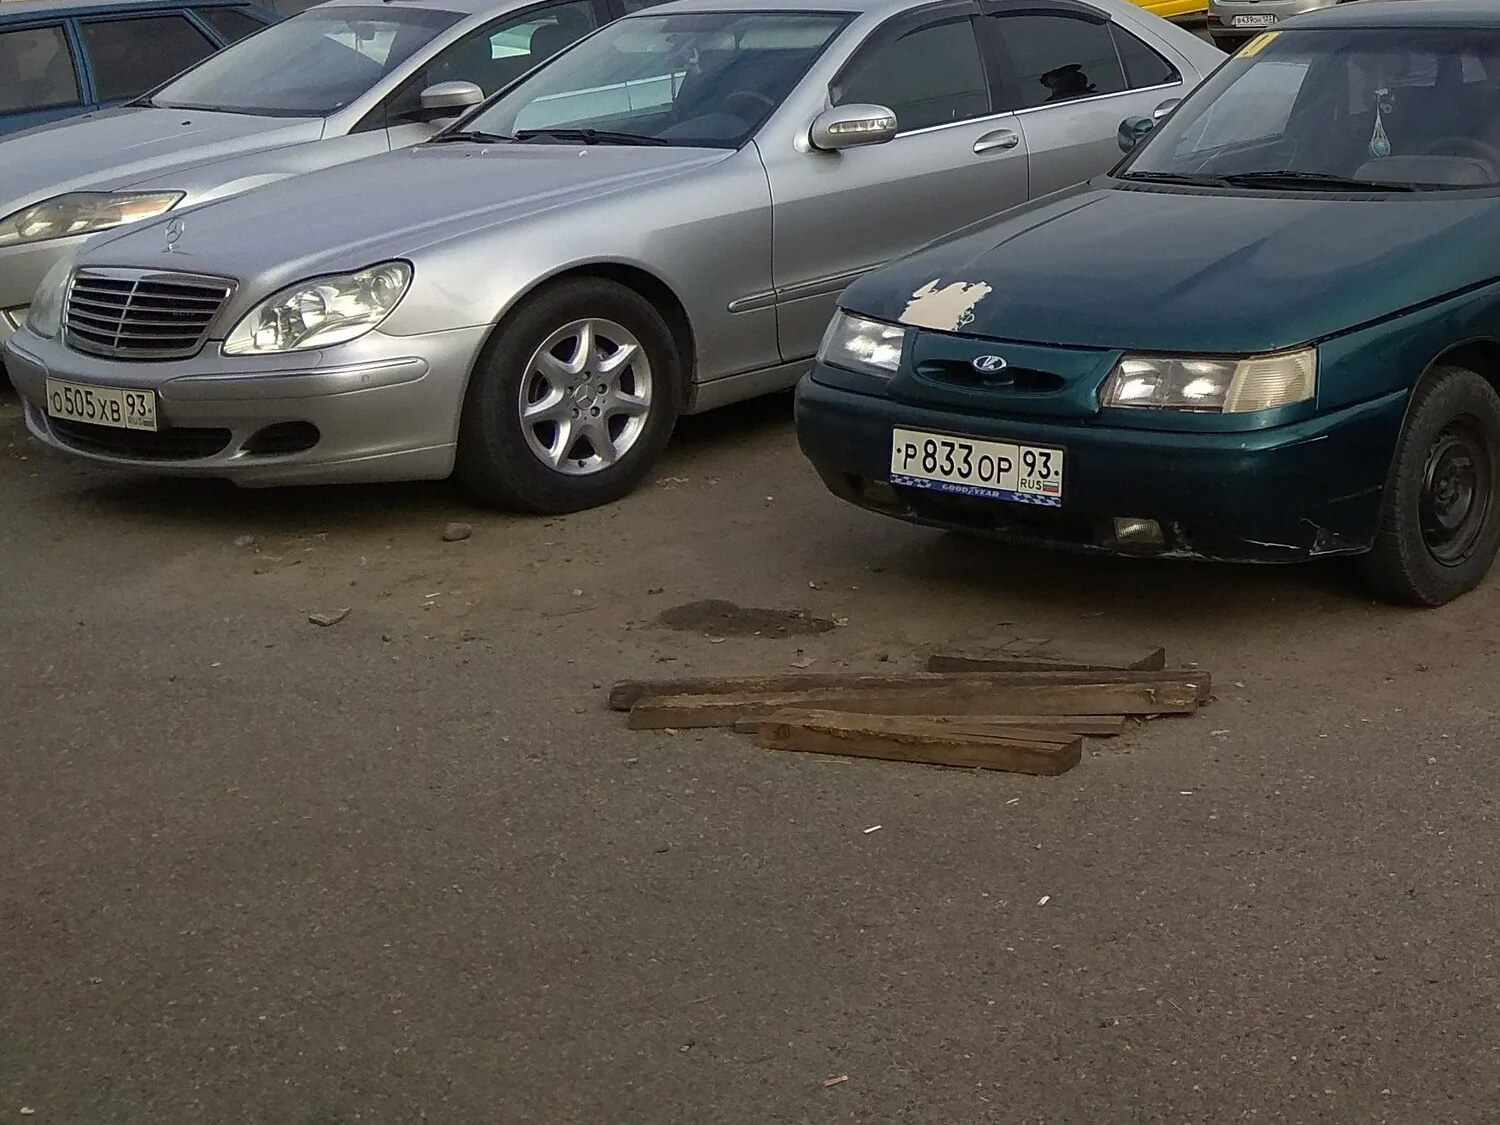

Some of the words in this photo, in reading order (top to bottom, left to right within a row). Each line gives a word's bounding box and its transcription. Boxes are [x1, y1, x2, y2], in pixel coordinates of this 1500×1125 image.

[126, 393, 146, 416] 93
[1023, 449, 1052, 479] 93
[941, 483, 1000, 498] GOODYEAR
[1020, 478, 1042, 491] RUS
